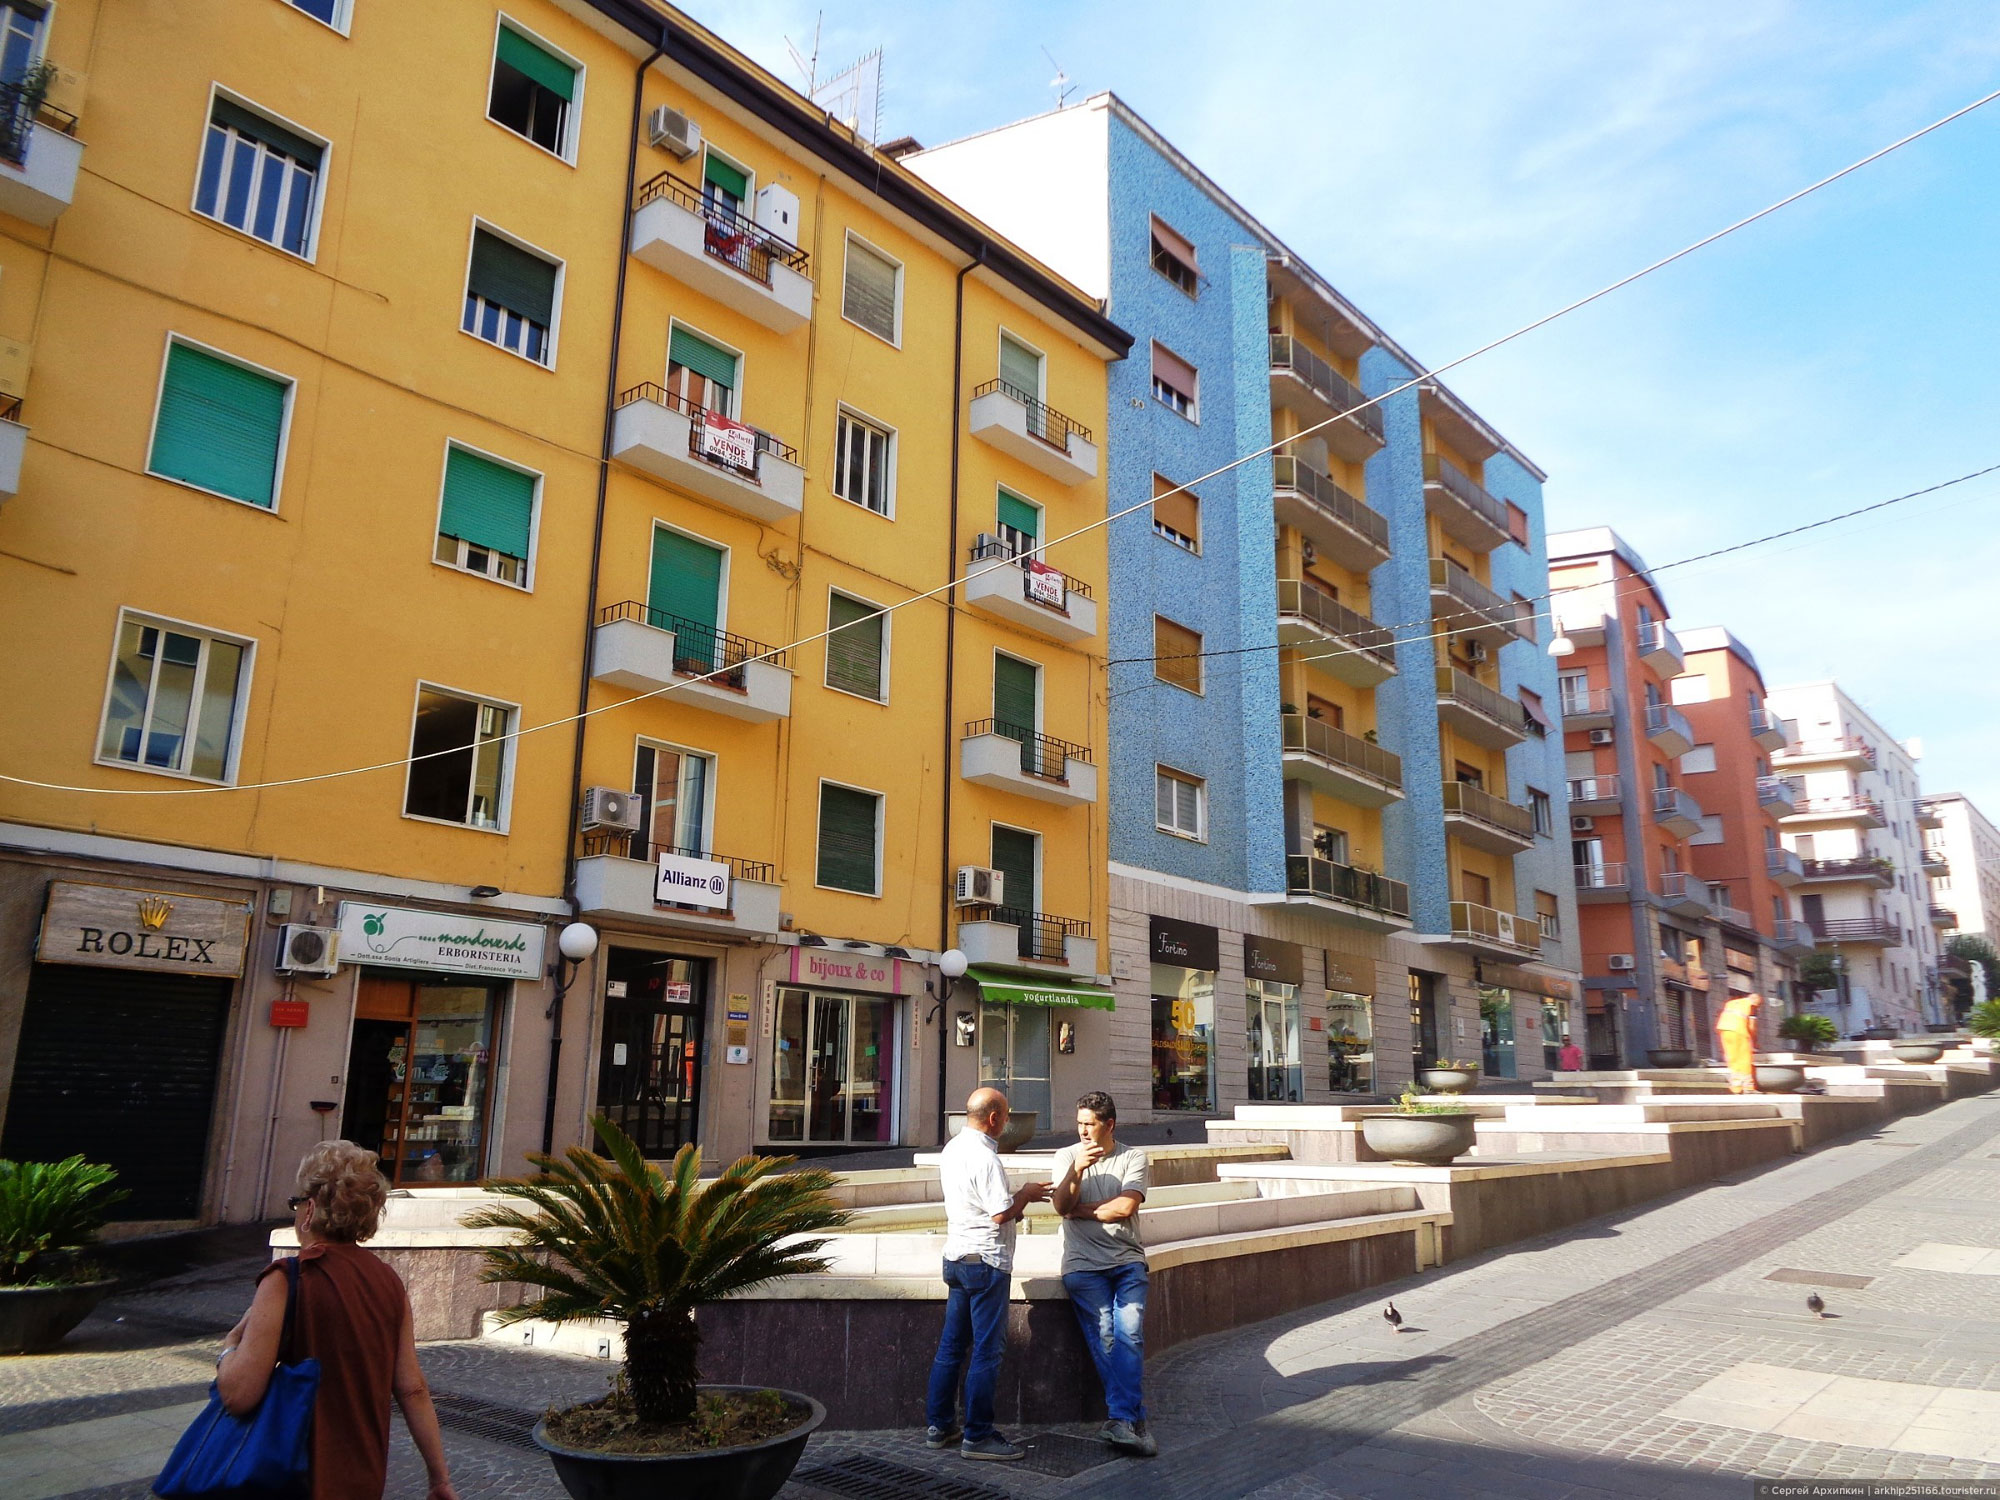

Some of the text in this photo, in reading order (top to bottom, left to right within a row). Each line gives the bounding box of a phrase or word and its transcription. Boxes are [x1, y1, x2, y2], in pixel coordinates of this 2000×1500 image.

[713, 436, 746, 459] VENDE
[1036, 580, 1058, 597] VENDE
[662, 869, 707, 889] Allianz
[77, 927, 216, 964] ROLEX
[438, 946, 521, 964] ERBORISTERIA
[1158, 931, 1188, 956] Fortino
[809, 956, 885, 982] bijoux & co
[1251, 949, 1277, 972] Fortino
[1023, 993, 1080, 1005] yogurtlandia
